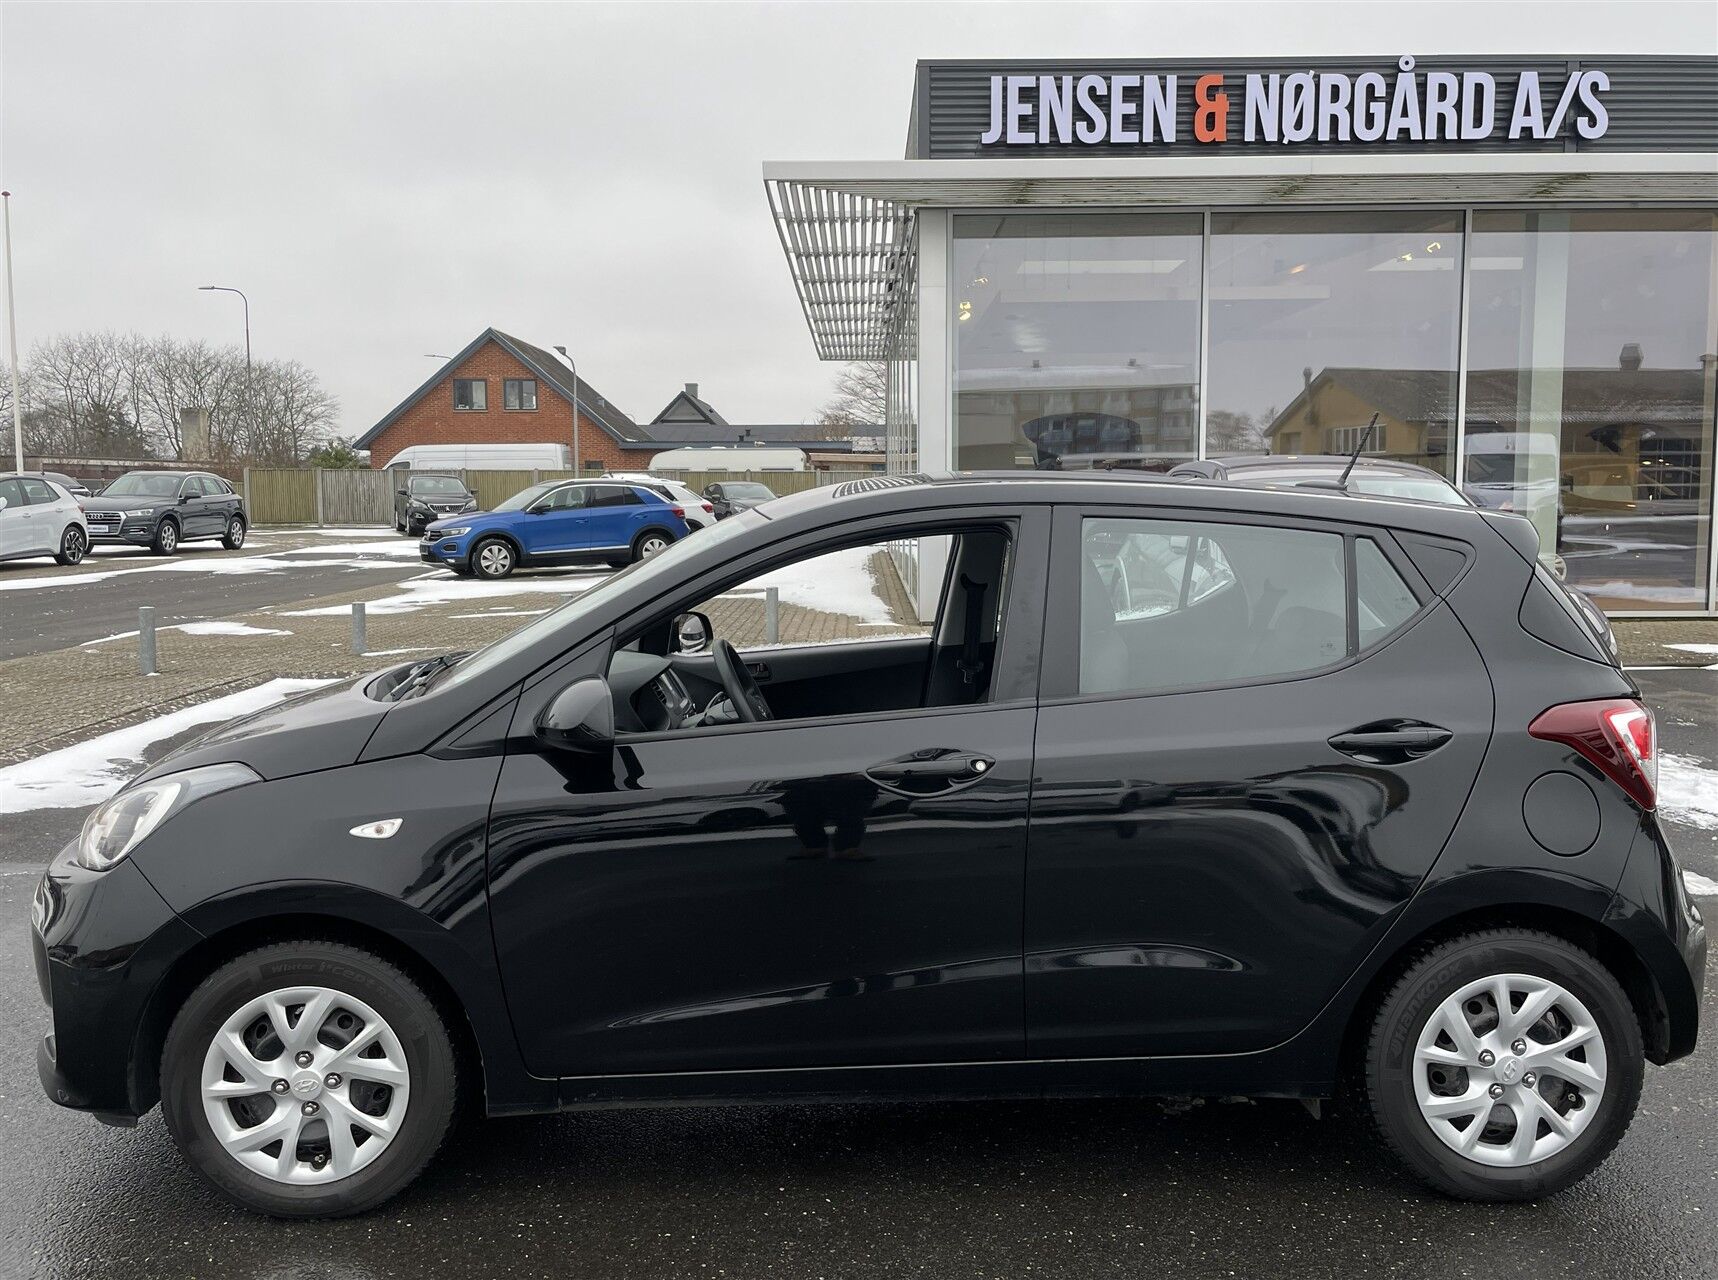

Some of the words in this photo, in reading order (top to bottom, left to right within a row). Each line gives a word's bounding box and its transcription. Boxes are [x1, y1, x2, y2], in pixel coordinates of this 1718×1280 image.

[982, 75, 1177, 144] JENSEN
[1194, 74, 1229, 142] &
[1244, 54, 1496, 145] NØRGÅRD
[1508, 71, 1610, 139] A/S
